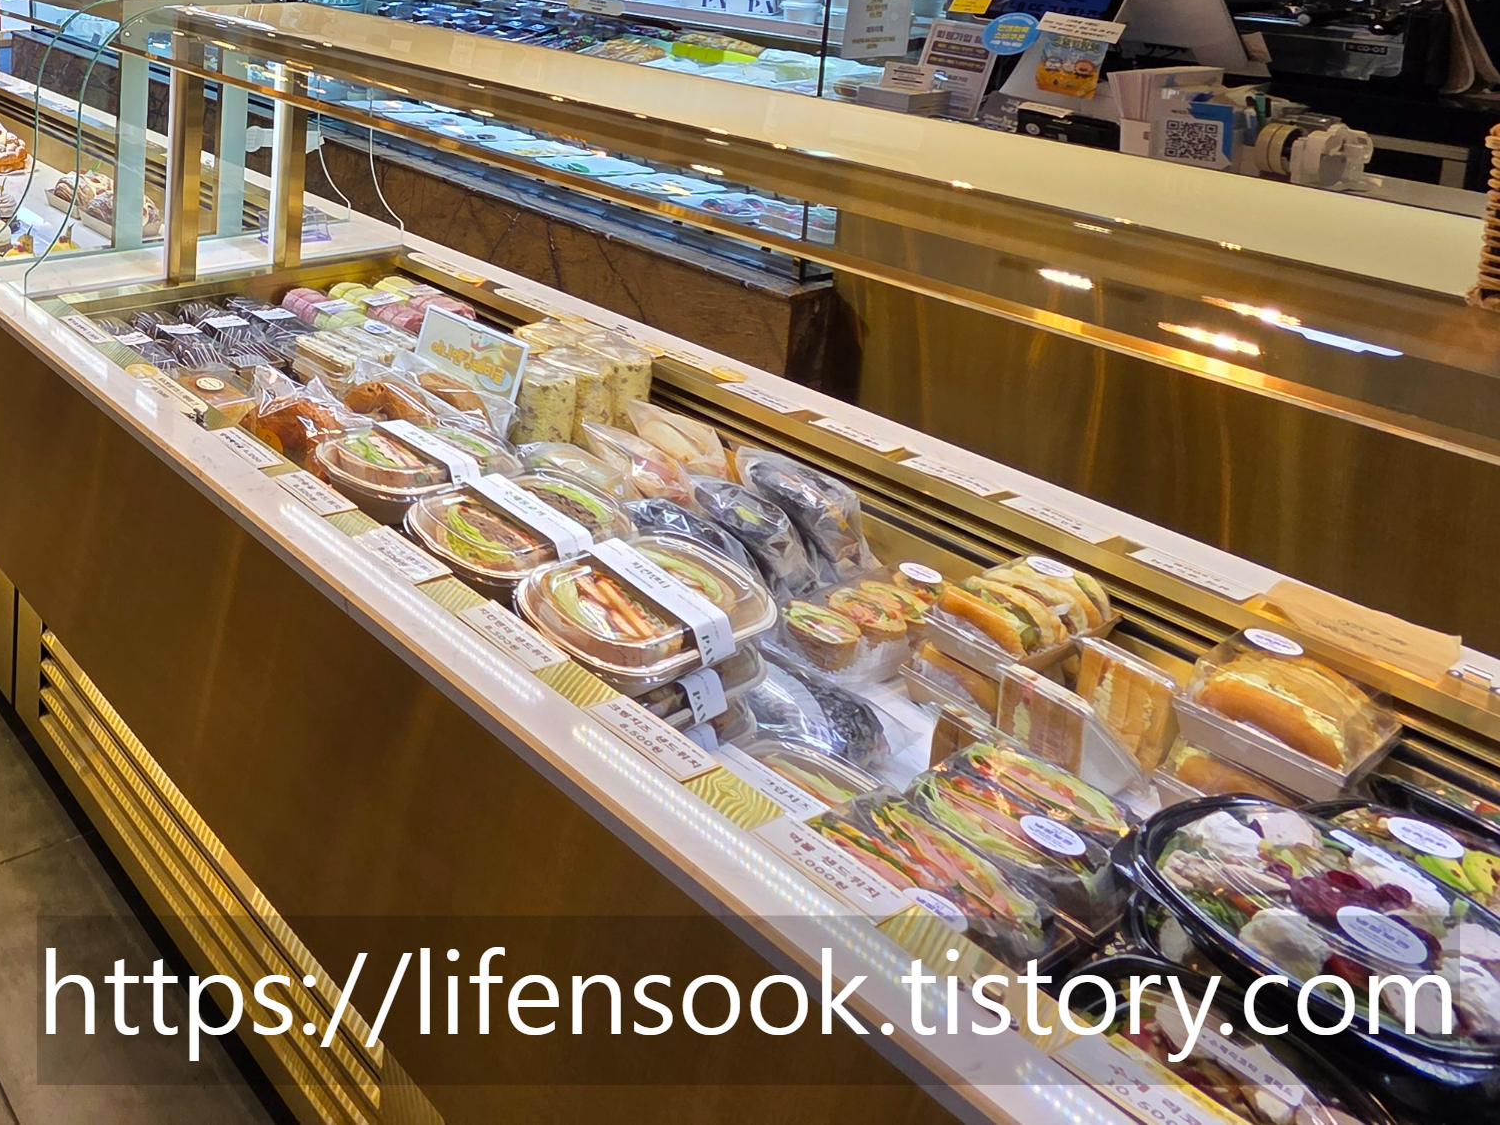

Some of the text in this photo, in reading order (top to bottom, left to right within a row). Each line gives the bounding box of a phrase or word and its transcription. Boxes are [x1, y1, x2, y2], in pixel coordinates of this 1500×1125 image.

[608, 702, 702, 769] 크림치즈 샌드위치
[821, 854, 881, 899] 샌드위치
